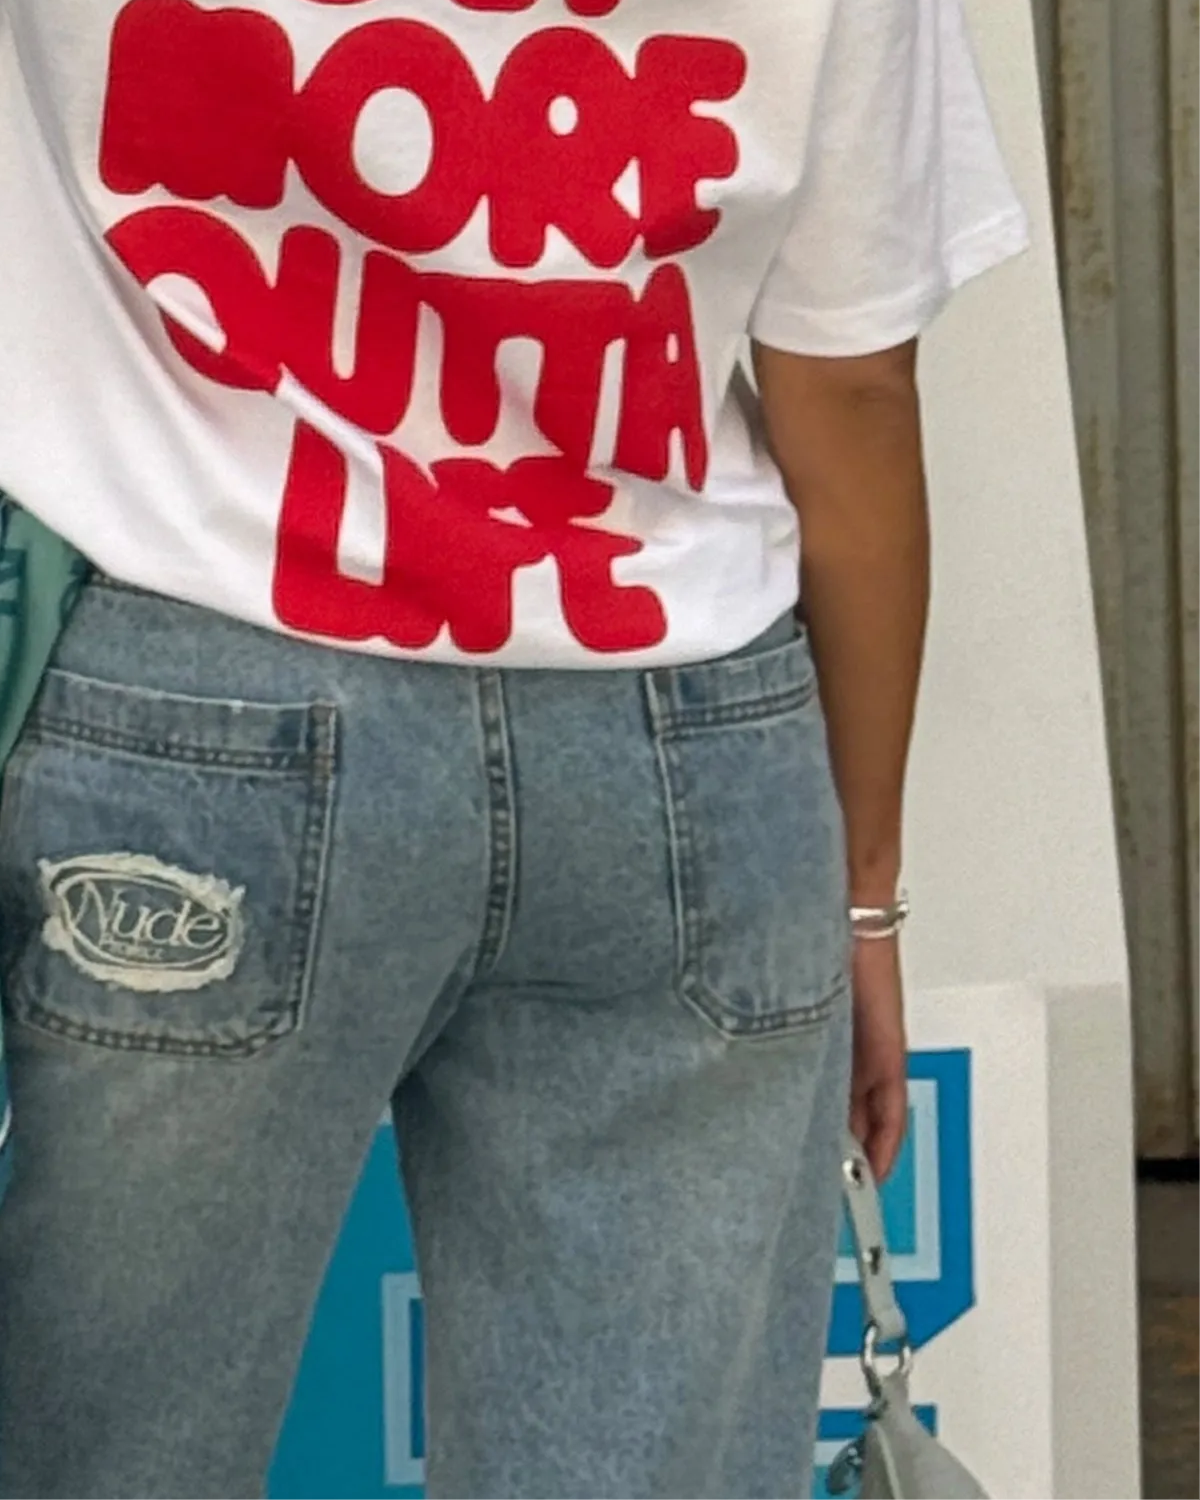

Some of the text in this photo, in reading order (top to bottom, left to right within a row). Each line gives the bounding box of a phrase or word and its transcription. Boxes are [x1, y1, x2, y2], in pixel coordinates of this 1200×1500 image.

[104, 206, 707, 492] OUTTA
[272, 417, 667, 653] LIFE
[72, 878, 226, 950] Nude
